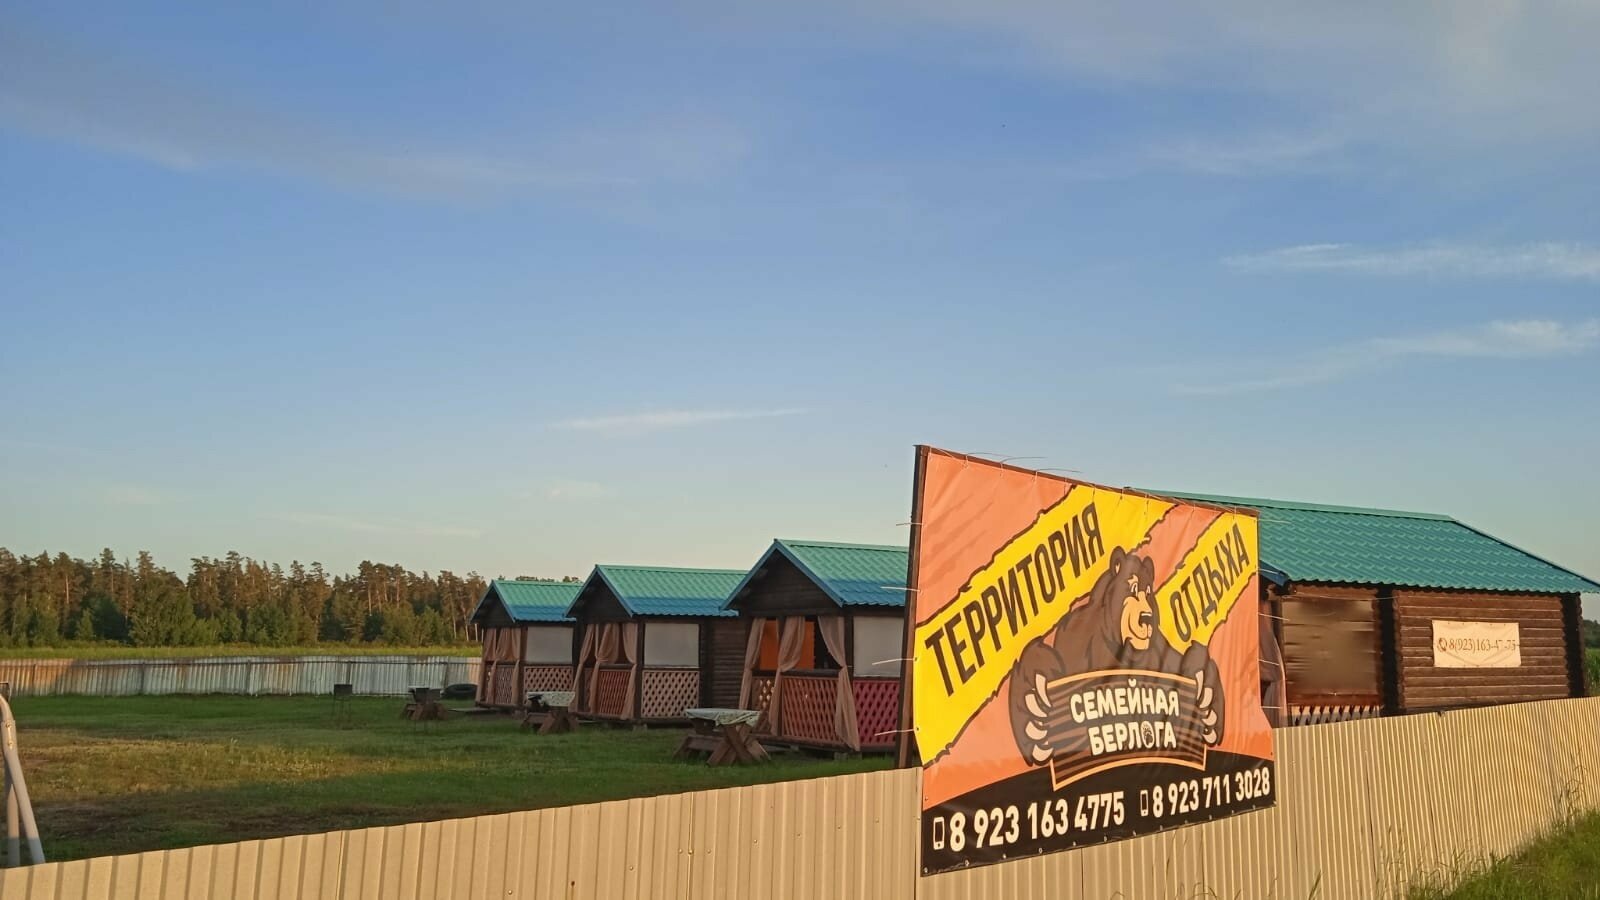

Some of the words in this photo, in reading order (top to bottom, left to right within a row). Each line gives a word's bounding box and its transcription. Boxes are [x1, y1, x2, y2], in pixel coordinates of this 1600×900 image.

[925, 502, 1105, 697] ТЕРРИТОРИЯ
[1169, 524, 1249, 641] ОТДЫХА
[1070, 679, 1179, 723] СЕМЕЙНАЯ
[1089, 721, 1177, 757] БЕРЛОГА
[1152, 790, 1163, 817] 8
[1169, 784, 1199, 815] 923
[1202, 774, 1230, 807] 711
[1235, 767, 1270, 802] 3028
[949, 813, 966, 852] 8
[975, 808, 1019, 848] 923
[1028, 803, 1068, 840] 163
[1074, 791, 1125, 832] 4775
